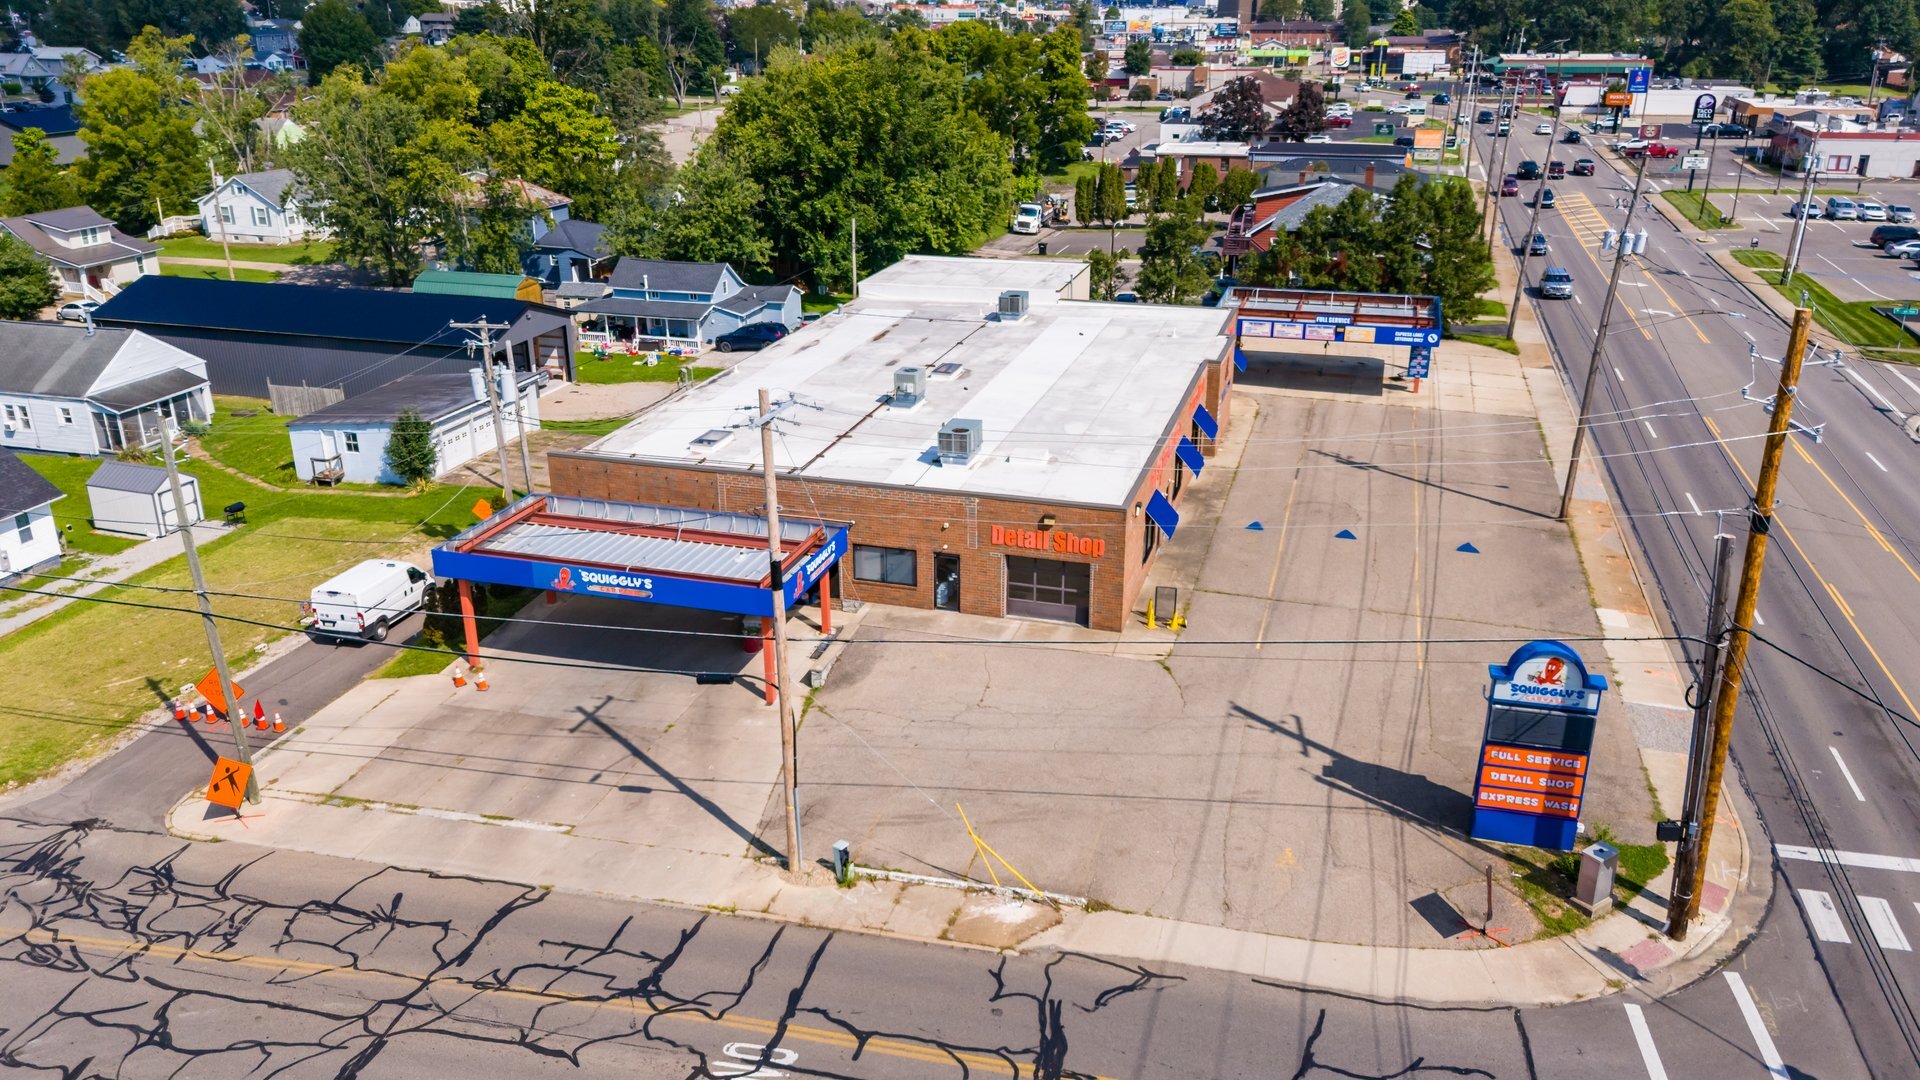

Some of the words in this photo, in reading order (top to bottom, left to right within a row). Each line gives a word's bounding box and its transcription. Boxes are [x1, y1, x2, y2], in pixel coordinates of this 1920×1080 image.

[991, 524, 1050, 550] Detail
[1053, 531, 1105, 558] Shop
[579, 569, 653, 589] SQUIGGLY'S
[1510, 683, 1585, 699] SQUIGGLY'S
[1490, 750, 1521, 761] FULL
[1526, 754, 1580, 768] SERVICE
[1490, 771, 1533, 784] DETAIL
[1539, 777, 1574, 789] SHOP
[1480, 792, 1539, 806] EXPRESS
[1544, 799, 1578, 811] WASH
